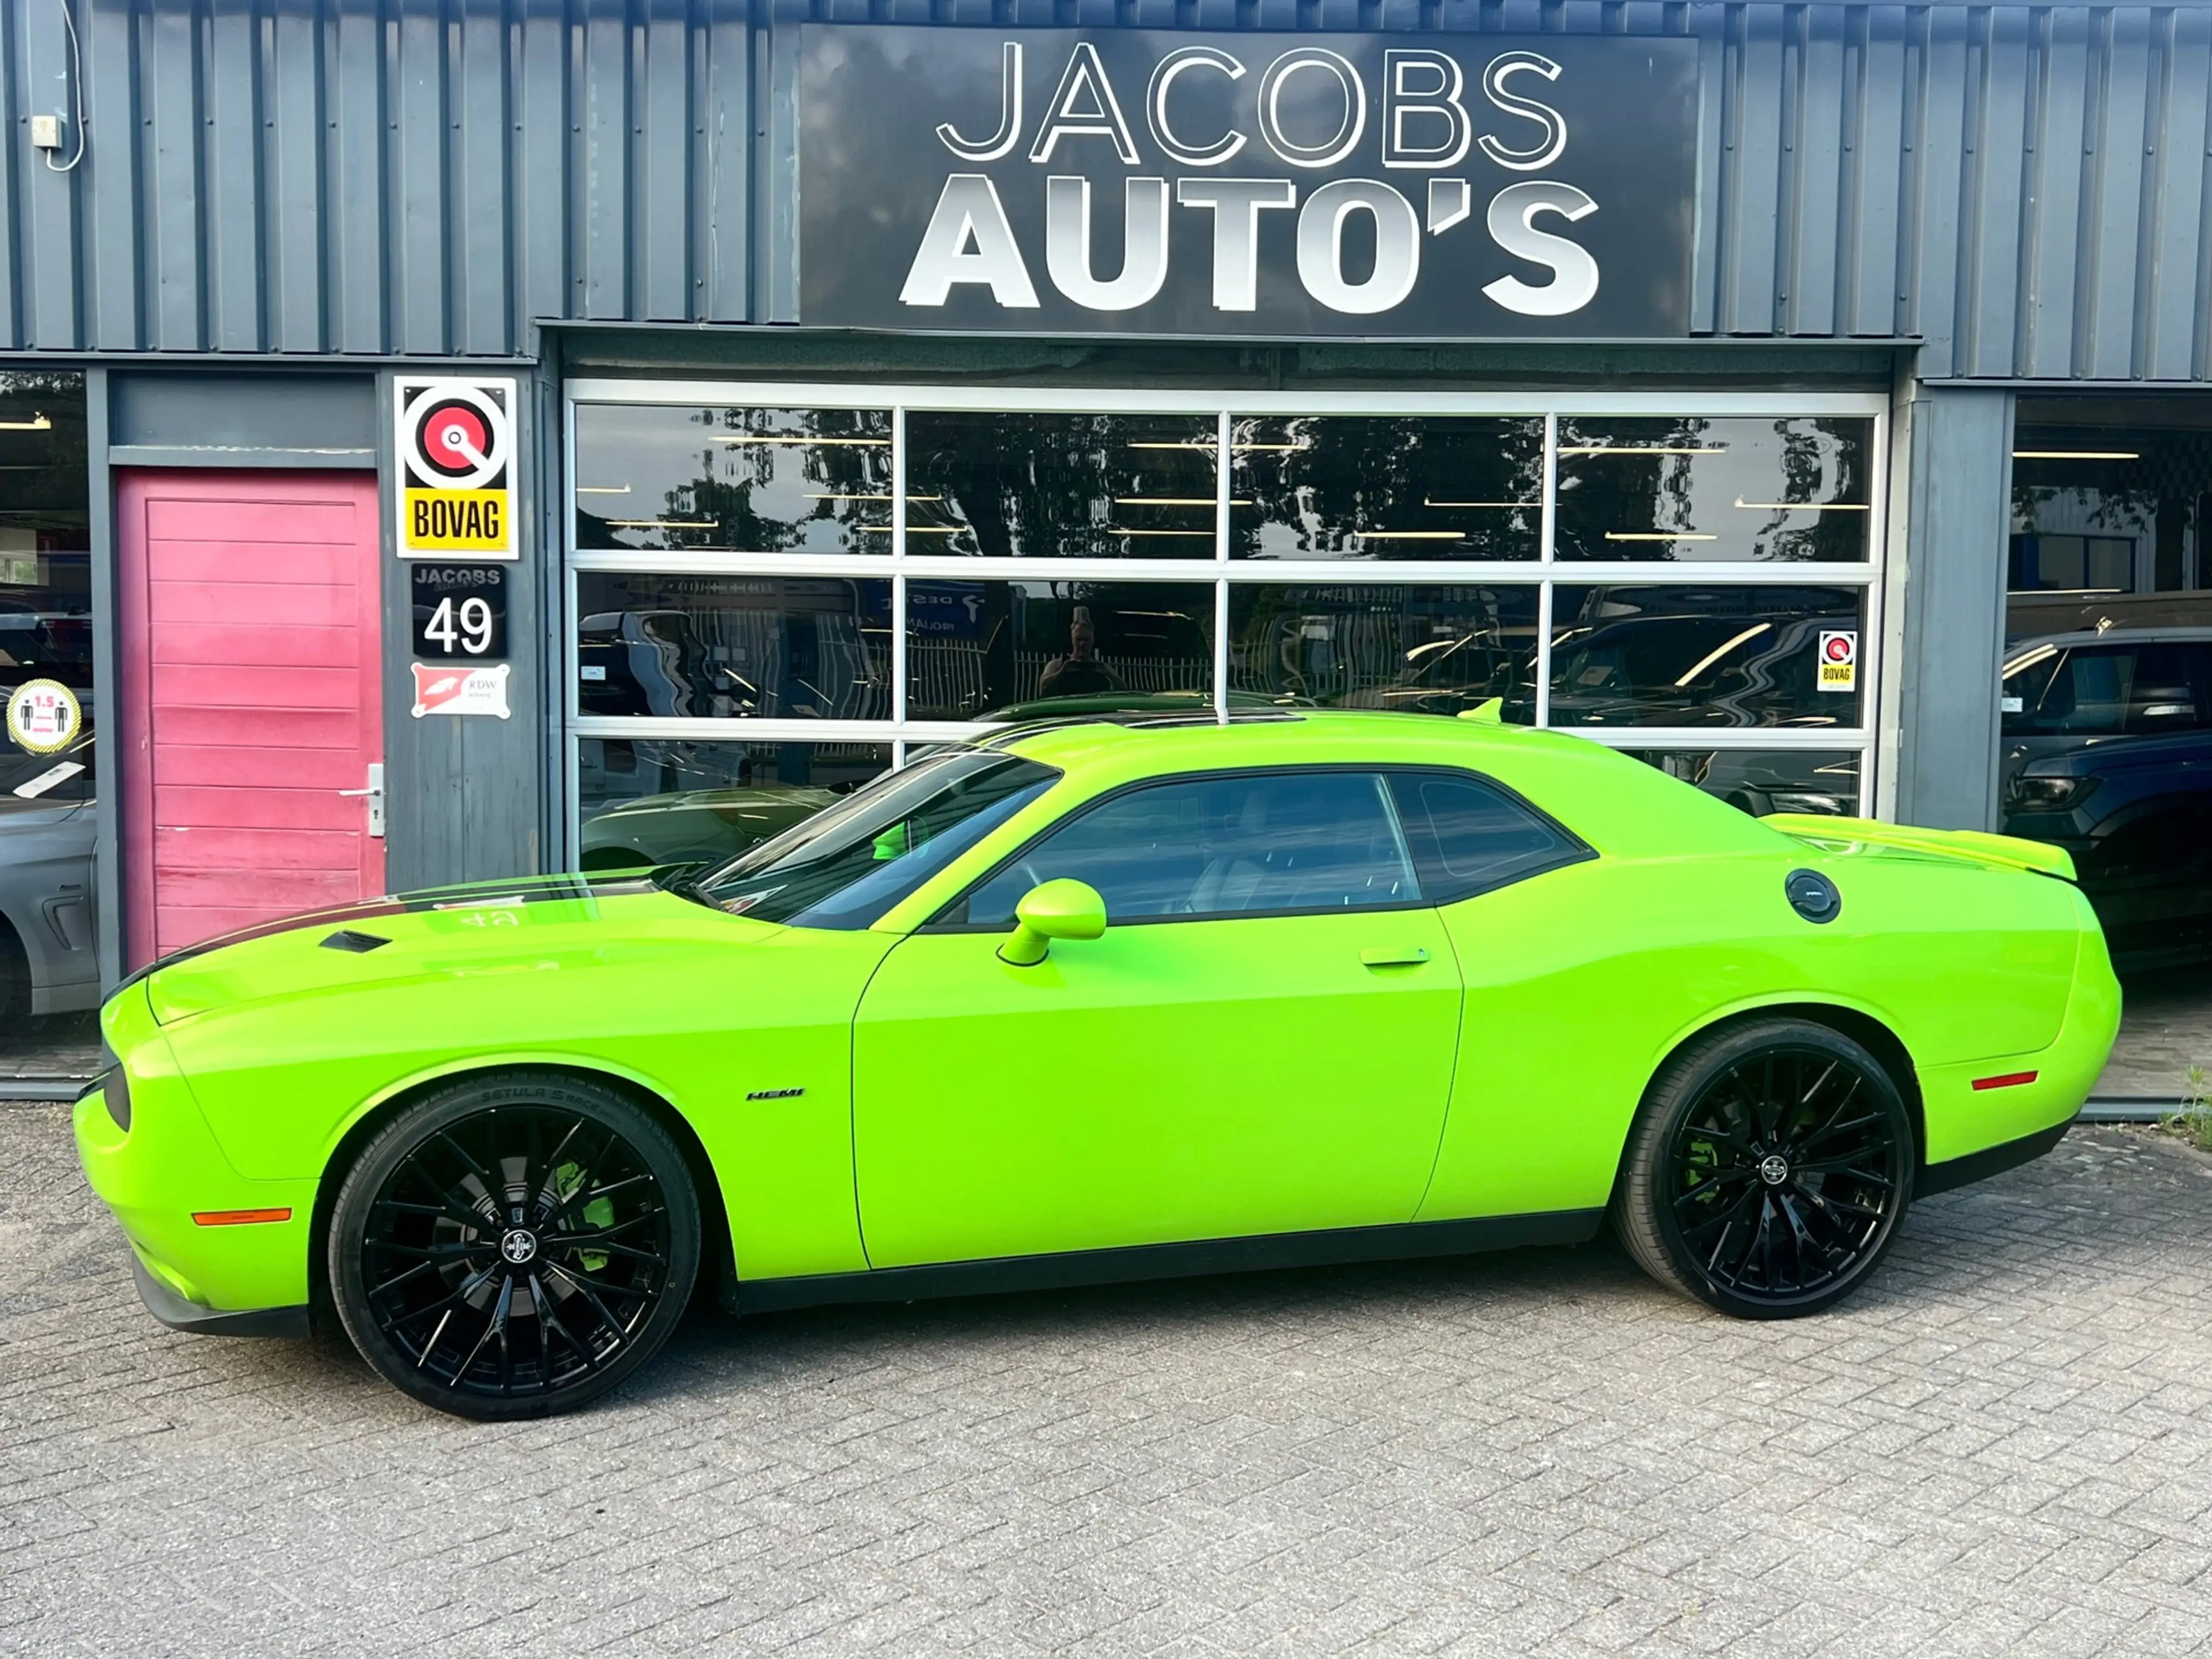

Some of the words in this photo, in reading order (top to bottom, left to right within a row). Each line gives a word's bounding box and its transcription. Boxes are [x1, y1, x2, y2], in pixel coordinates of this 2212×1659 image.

[935, 41, 1567, 171] JACOBS
[898, 173, 1600, 316] AUTO'S
[414, 499, 499, 539] BOVAG
[415, 569, 500, 585] JACOBS
[424, 597, 492, 654] 49
[1823, 668, 1850, 680] BOVAG
[469, 680, 498, 690] RDW
[35, 696, 54, 708] 1.5
[482, 1088, 546, 1103] SETULA
[745, 1088, 806, 1101] HEMI
